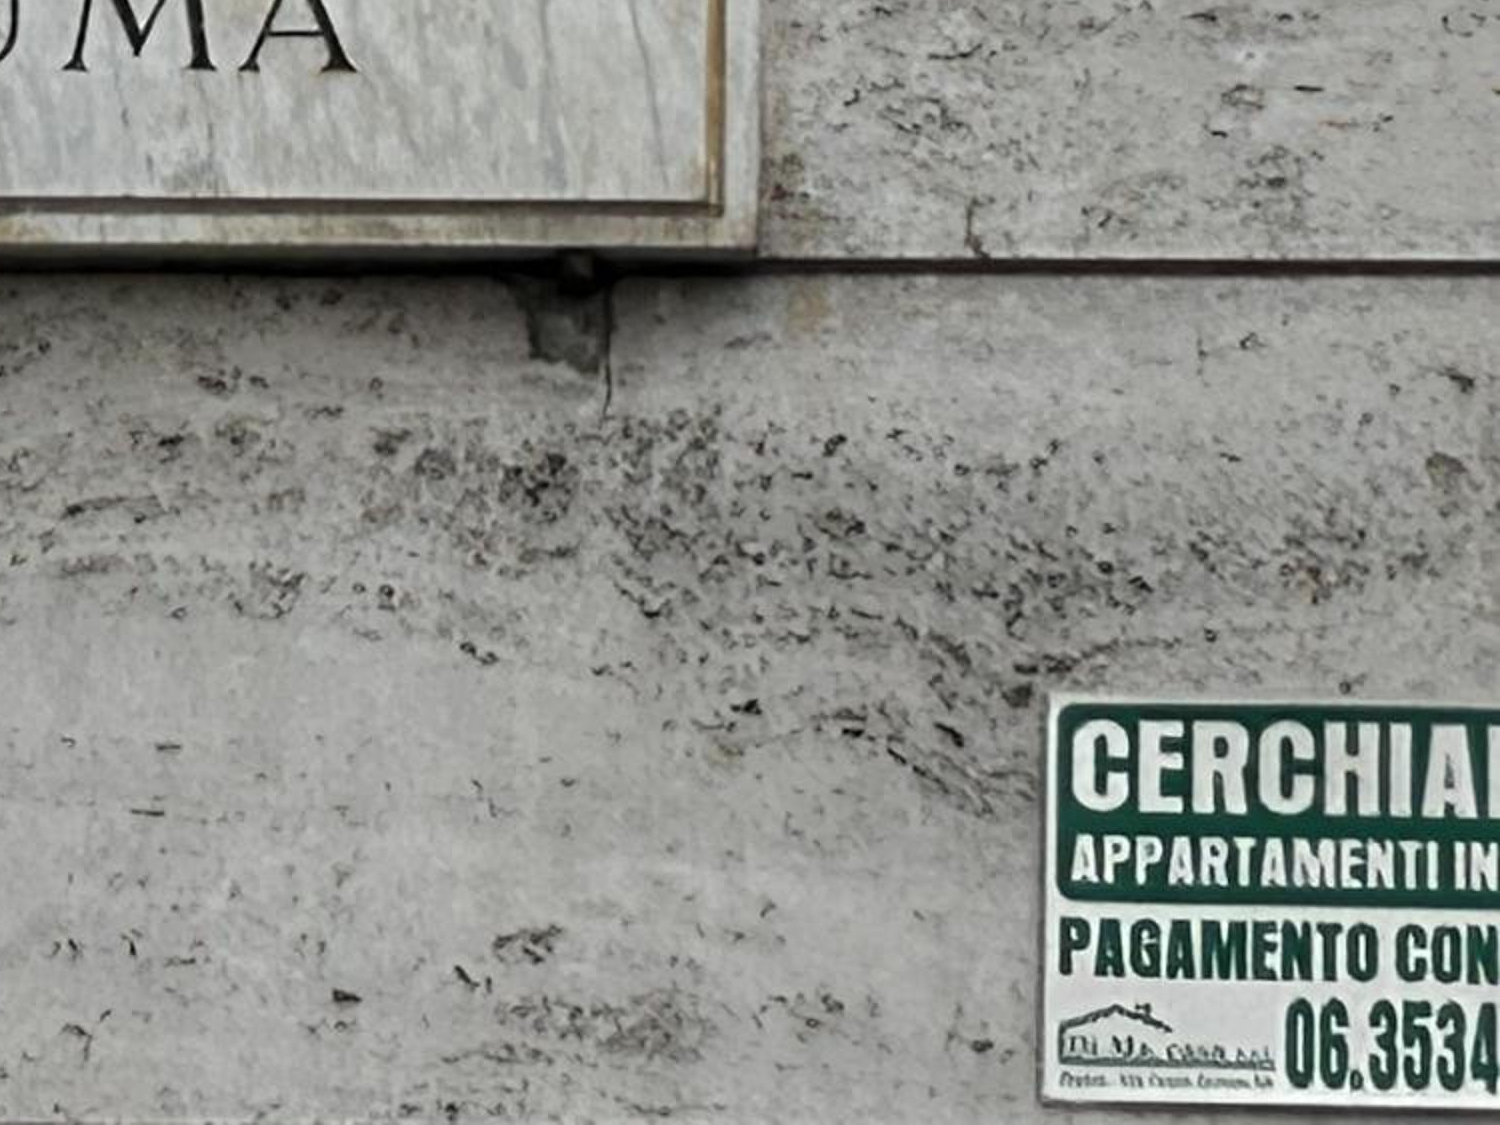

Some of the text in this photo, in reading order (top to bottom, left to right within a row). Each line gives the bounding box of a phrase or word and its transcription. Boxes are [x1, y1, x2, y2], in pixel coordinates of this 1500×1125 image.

[1071, 719, 1500, 819] CERCHIA
[1071, 834, 1499, 892] APPARTAMENTI IN
[1059, 916, 1499, 985] PAGAMENTO CON
[1285, 997, 1499, 1095] 06.3534
